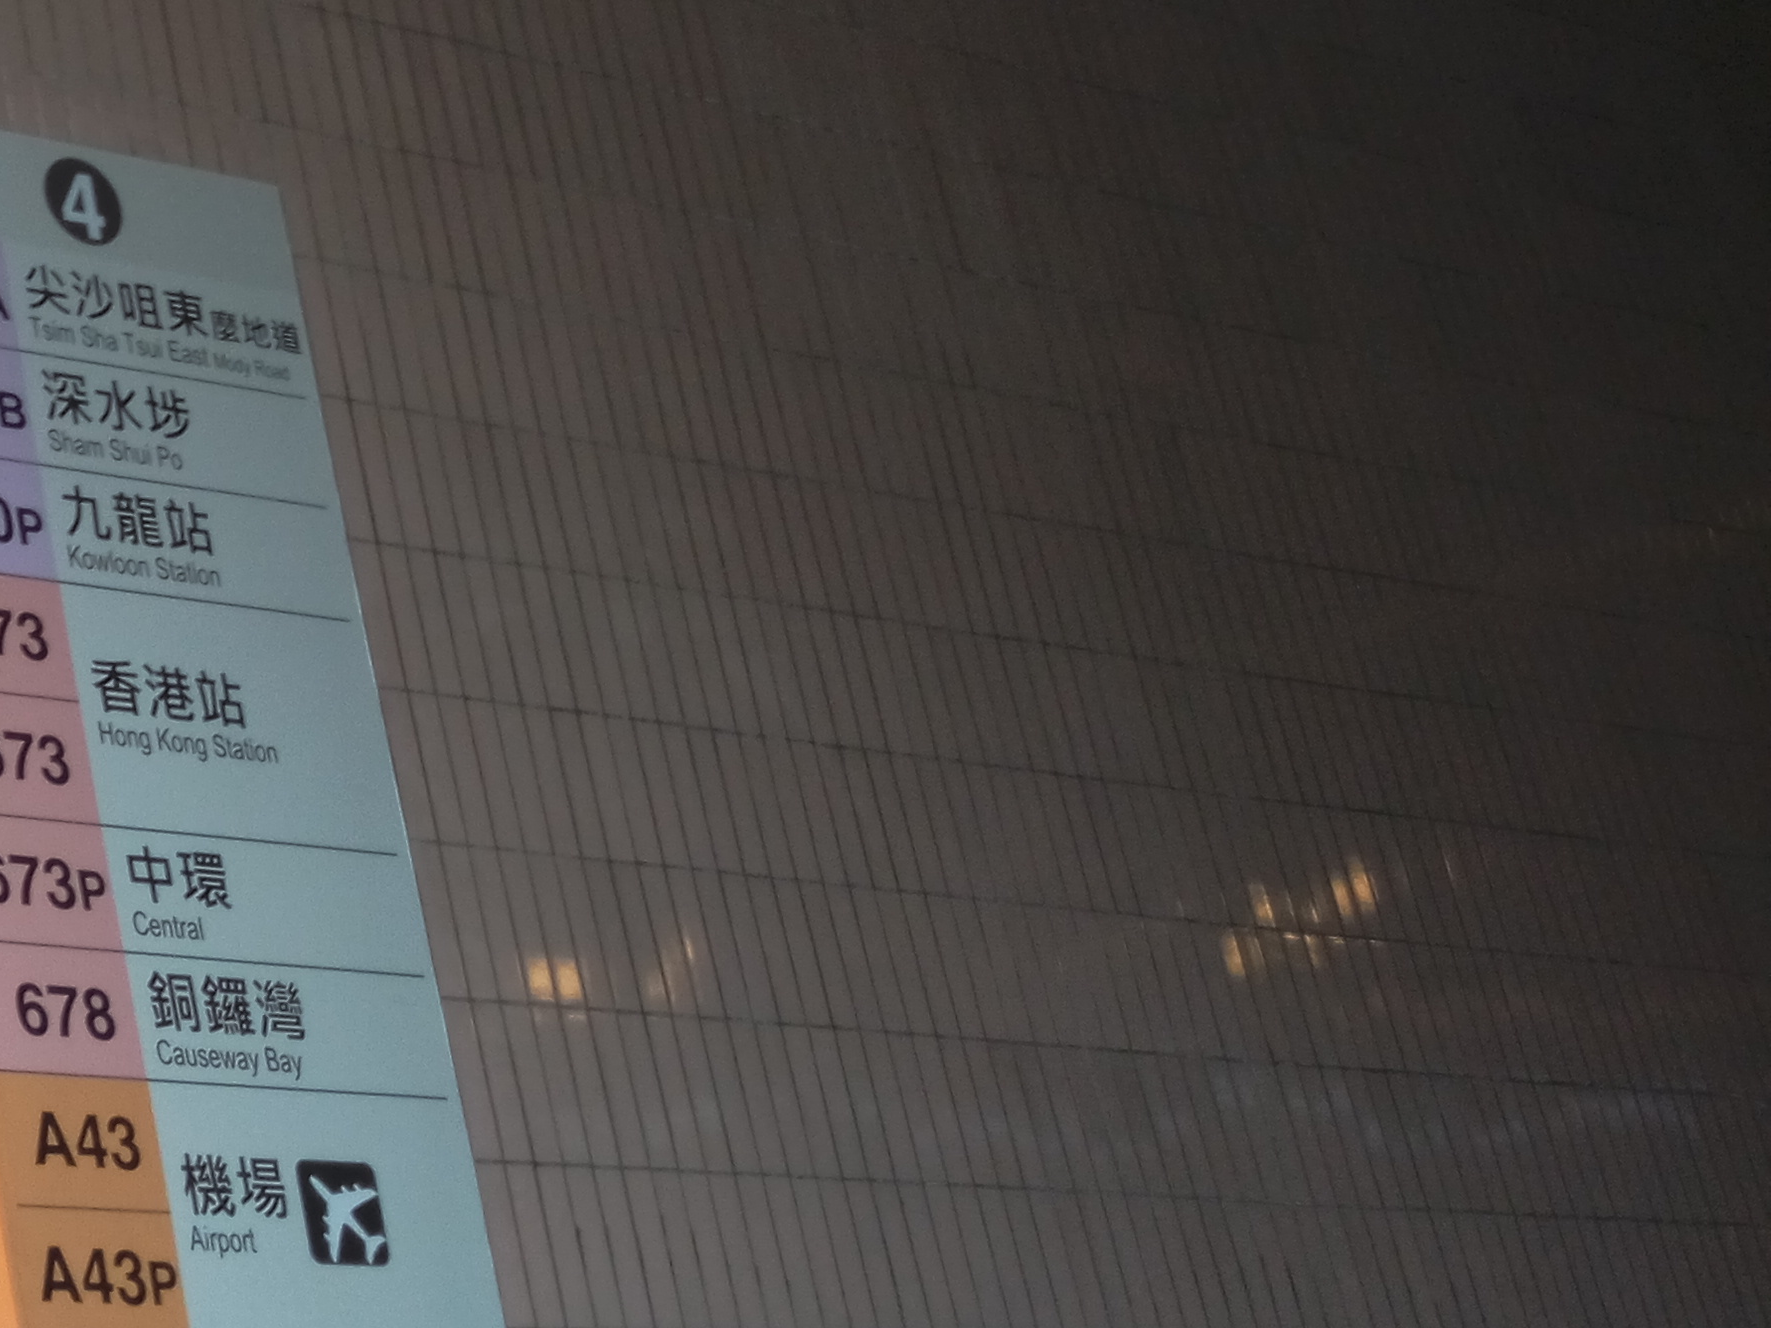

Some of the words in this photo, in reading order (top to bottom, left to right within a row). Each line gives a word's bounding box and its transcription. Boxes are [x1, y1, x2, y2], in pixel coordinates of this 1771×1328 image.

[60, 172, 107, 241] 4
[28, 316, 75, 342] Tsim
[79, 325, 118, 352] Sha
[122, 332, 163, 358] Tsui
[167, 340, 209, 367] East
[42, 368, 190, 439] 深水埗
[47, 428, 104, 459] Sham
[109, 438, 152, 466] Shui
[157, 446, 184, 471] Po
[62, 485, 213, 556] 九龍站
[66, 544, 149, 578] Kowloon
[155, 556, 222, 587] Station
[91, 659, 247, 729] 香港站
[97, 721, 151, 756] Hong
[156, 728, 208, 762] Kong
[213, 734, 280, 764] Station
[126, 845, 232, 909] 中環
[132, 910, 205, 941] Central
[15, 982, 116, 1042] 678
[147, 970, 307, 1041] 銅鑼灣
[156, 1038, 260, 1078] Causeway
[263, 1046, 304, 1082] Bay
[34, 1110, 142, 1172] A43
[180, 1151, 288, 1221] 機場
[189, 1223, 257, 1259] Airport
[41, 1246, 178, 1307] A43P
